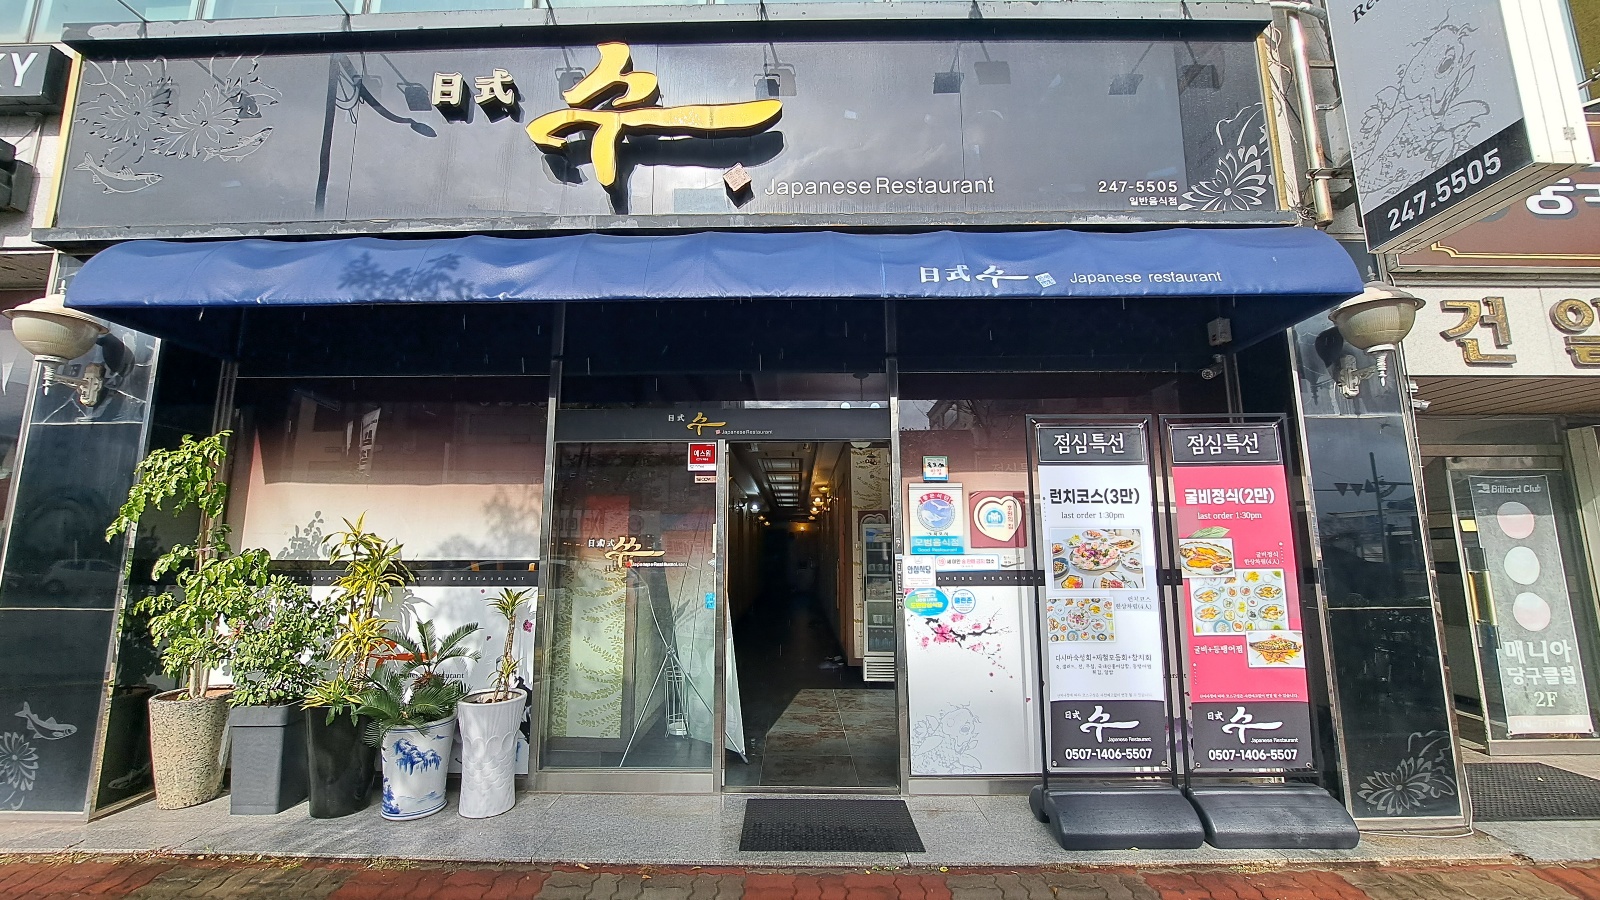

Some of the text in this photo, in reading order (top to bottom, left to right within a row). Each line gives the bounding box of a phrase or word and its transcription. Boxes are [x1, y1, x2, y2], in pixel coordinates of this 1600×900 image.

[0, 53, 38, 87] Y
[432, 68, 513, 107] 日式
[765, 177, 995, 198] Japanese Restaurant
[1098, 180, 1178, 193] 247-5505
[1386, 147, 1502, 231] 247.5505
[1129, 196, 1178, 206] 일반음식점
[920, 265, 970, 283] 日式
[1069, 271, 1142, 285] Japanese
[1148, 270, 1222, 283] restaurant
[668, 413, 685, 422] 日式
[1053, 432, 1125, 455] 점심특선
[1187, 432, 1260, 455] 점심특선
[1050, 487, 1140, 505] 런치코스(3만)
[1184, 487, 1275, 505] 굴비정식(2만)
[1491, 484, 1541, 494] Billiard Club
[1061, 511, 1125, 521] last order 1:30pm
[1197, 511, 1263, 521] last order 1:30pm
[915, 537, 959, 547] 모범음식점
[1502, 639, 1573, 665] 매니아
[1506, 665, 1577, 686] 당구클럽
[1533, 691, 1558, 707] 2F
[1065, 710, 1082, 720] 日式
[1207, 711, 1225, 721] 日式
[1065, 748, 1153, 760] 0507-1406-5507
[1208, 749, 1298, 761] 0507-1406-5507
